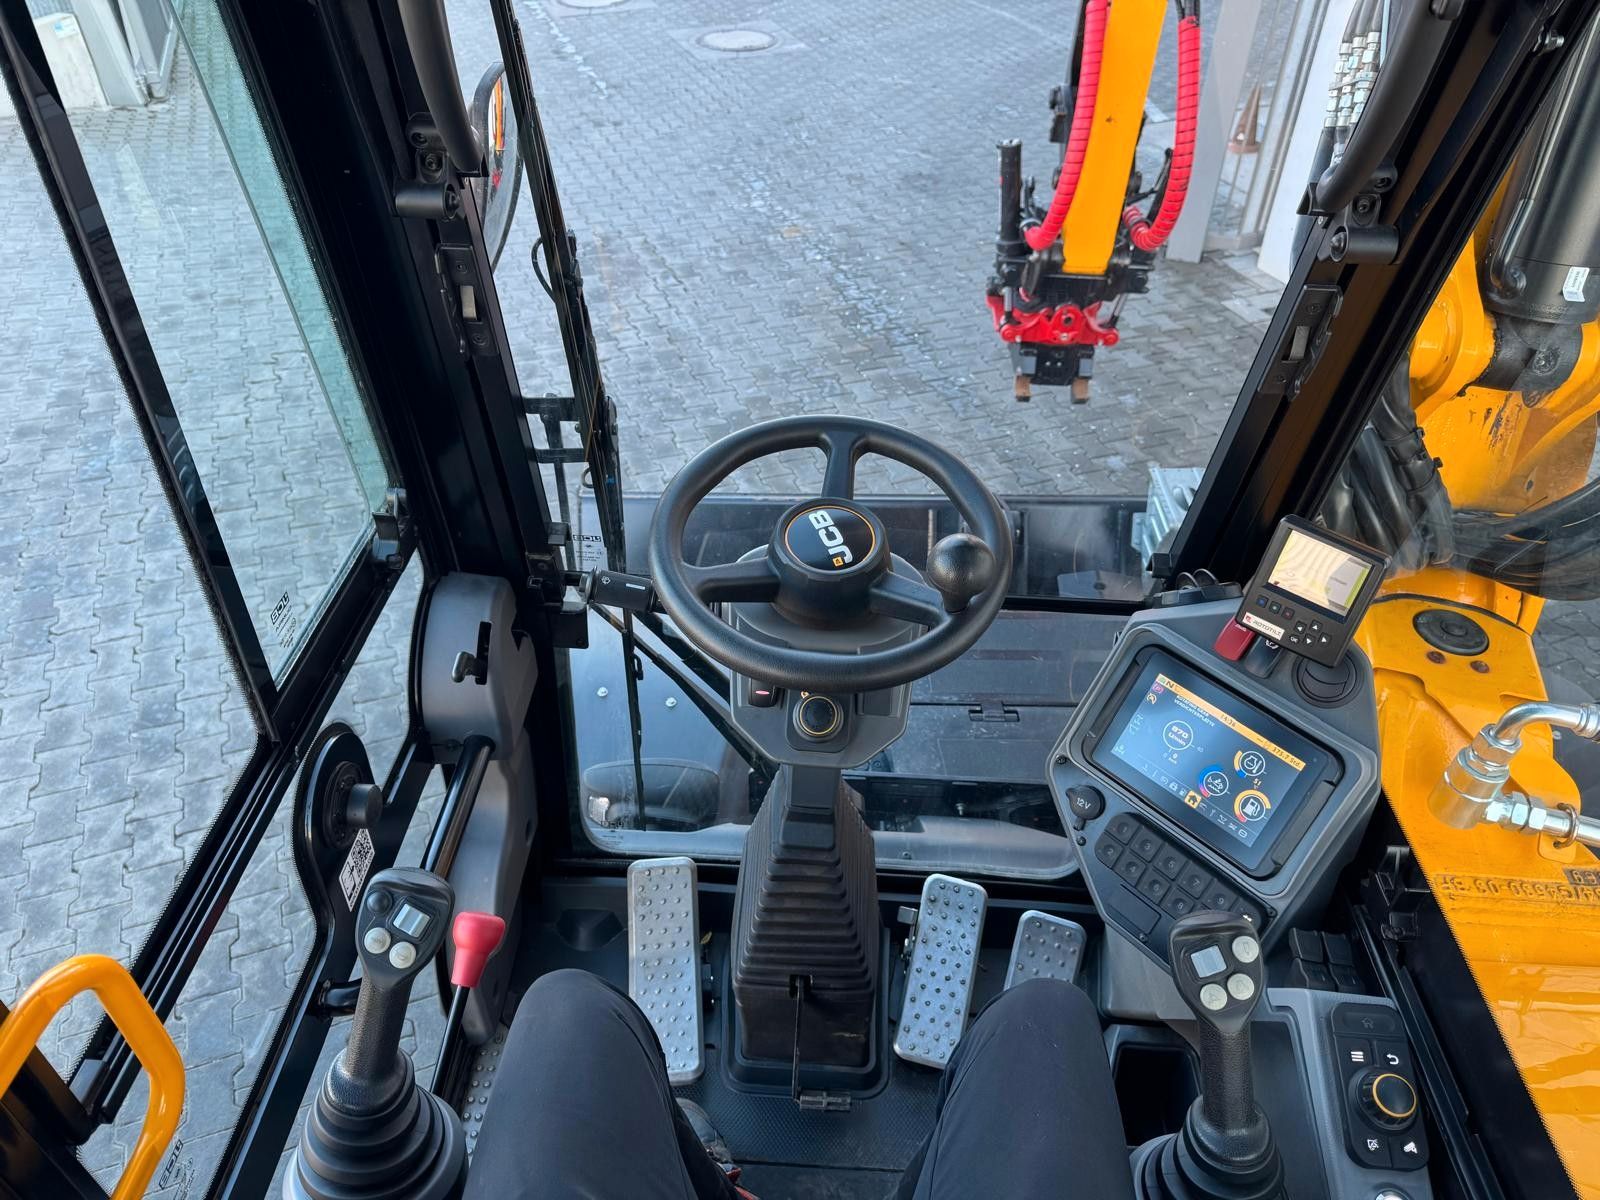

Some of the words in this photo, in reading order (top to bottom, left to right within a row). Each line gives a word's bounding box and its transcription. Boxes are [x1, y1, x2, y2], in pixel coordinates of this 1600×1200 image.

[808, 510, 853, 564] JCB
[1166, 681, 1175, 689] N
[1076, 797, 1091, 809] 12V
